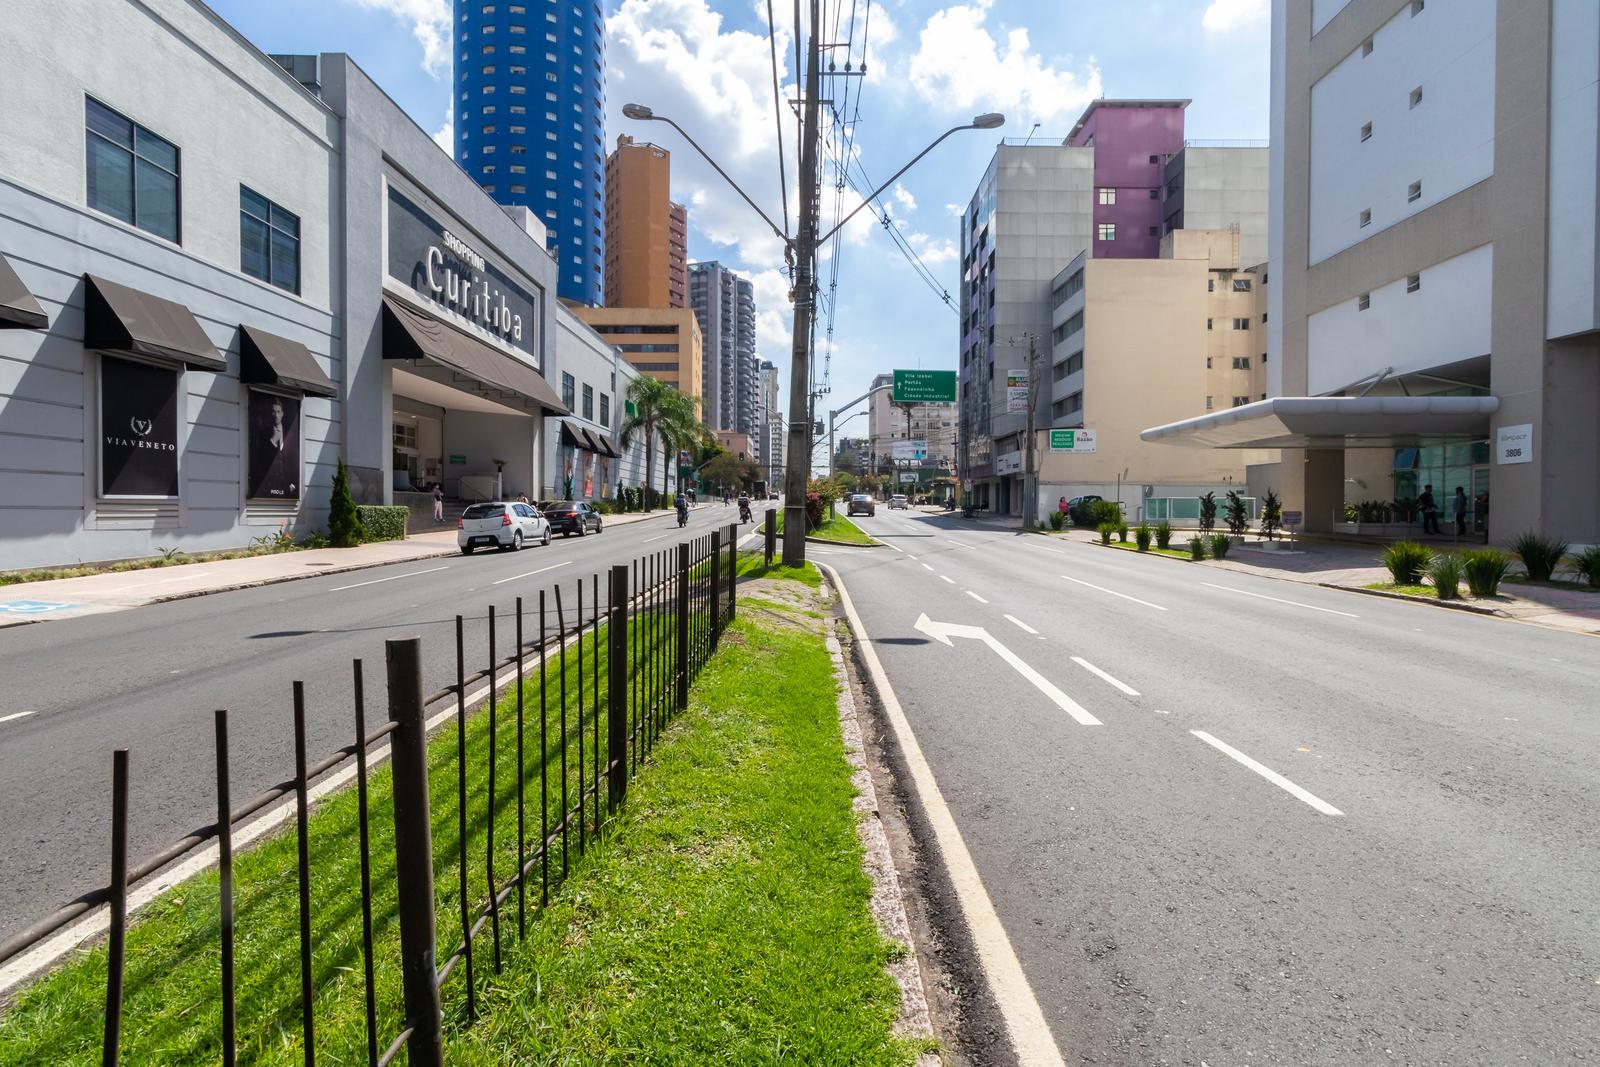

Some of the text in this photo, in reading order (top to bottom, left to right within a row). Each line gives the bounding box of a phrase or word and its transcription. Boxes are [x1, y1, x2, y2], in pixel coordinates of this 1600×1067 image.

[443, 230, 485, 272] SHOPPING
[426, 246, 522, 341] Curitiba
[1505, 447, 1522, 458] 3806
